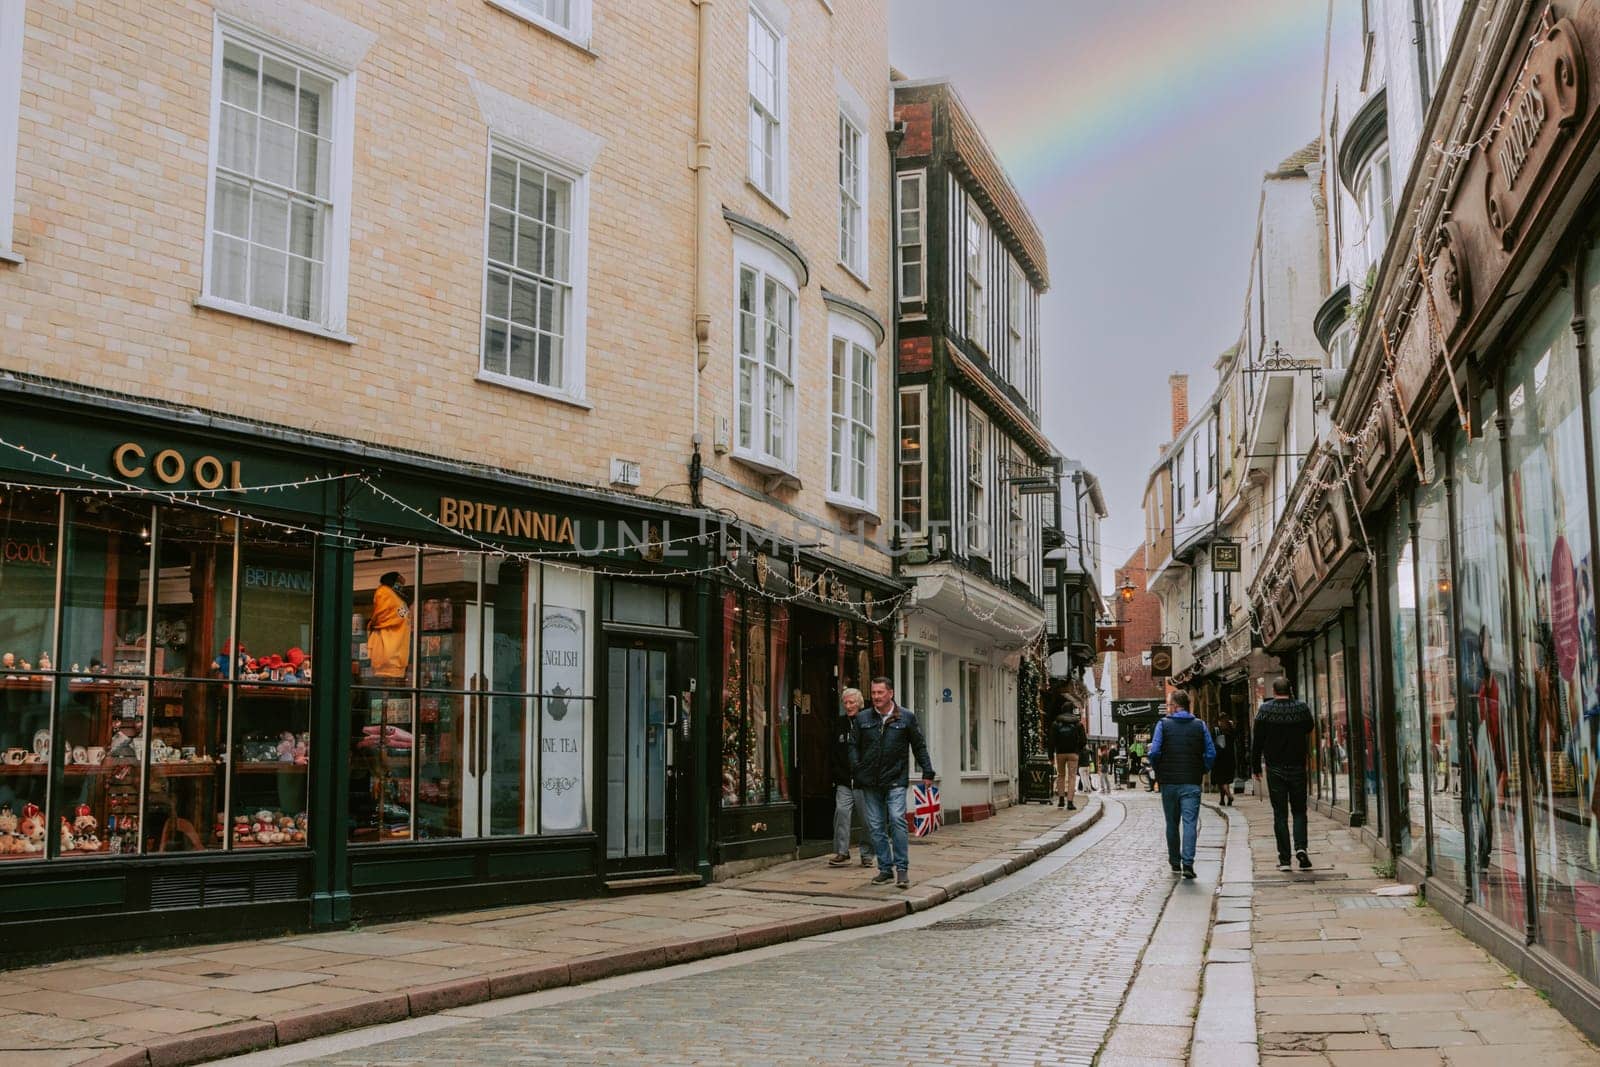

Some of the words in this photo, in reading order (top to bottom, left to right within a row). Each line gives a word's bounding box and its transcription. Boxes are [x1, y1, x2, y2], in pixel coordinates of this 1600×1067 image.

[112, 441, 248, 494] COOL
[439, 496, 575, 545] BRITANNIA
[4, 541, 53, 566] COOL
[543, 648, 578, 667] NGLISH
[560, 737, 578, 753] TEA
